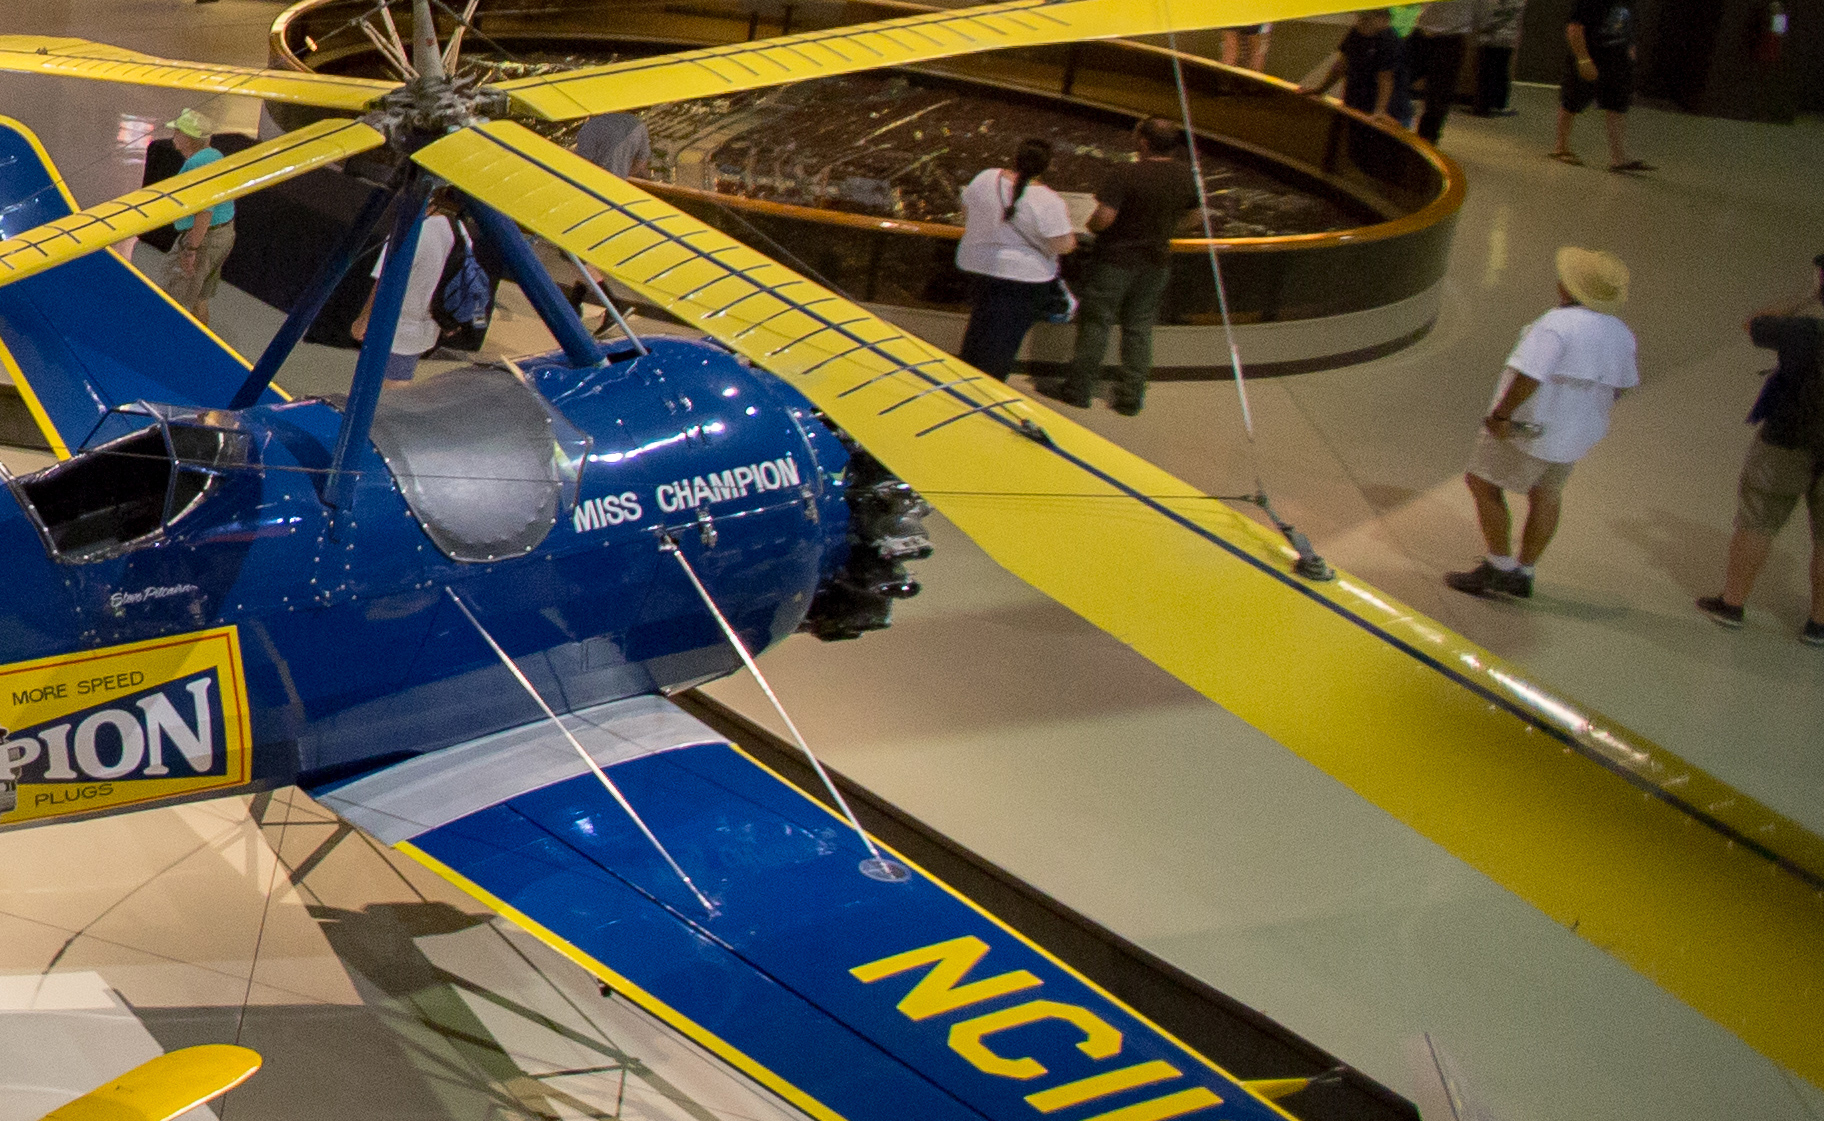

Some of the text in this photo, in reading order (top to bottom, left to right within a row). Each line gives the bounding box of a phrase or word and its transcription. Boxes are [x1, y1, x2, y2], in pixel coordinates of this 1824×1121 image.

[572, 456, 801, 534] MISS CHAMPION
[12, 683, 67, 706] MORE
[77, 670, 144, 695] SPEED
[34, 783, 114, 807] PLUGS
